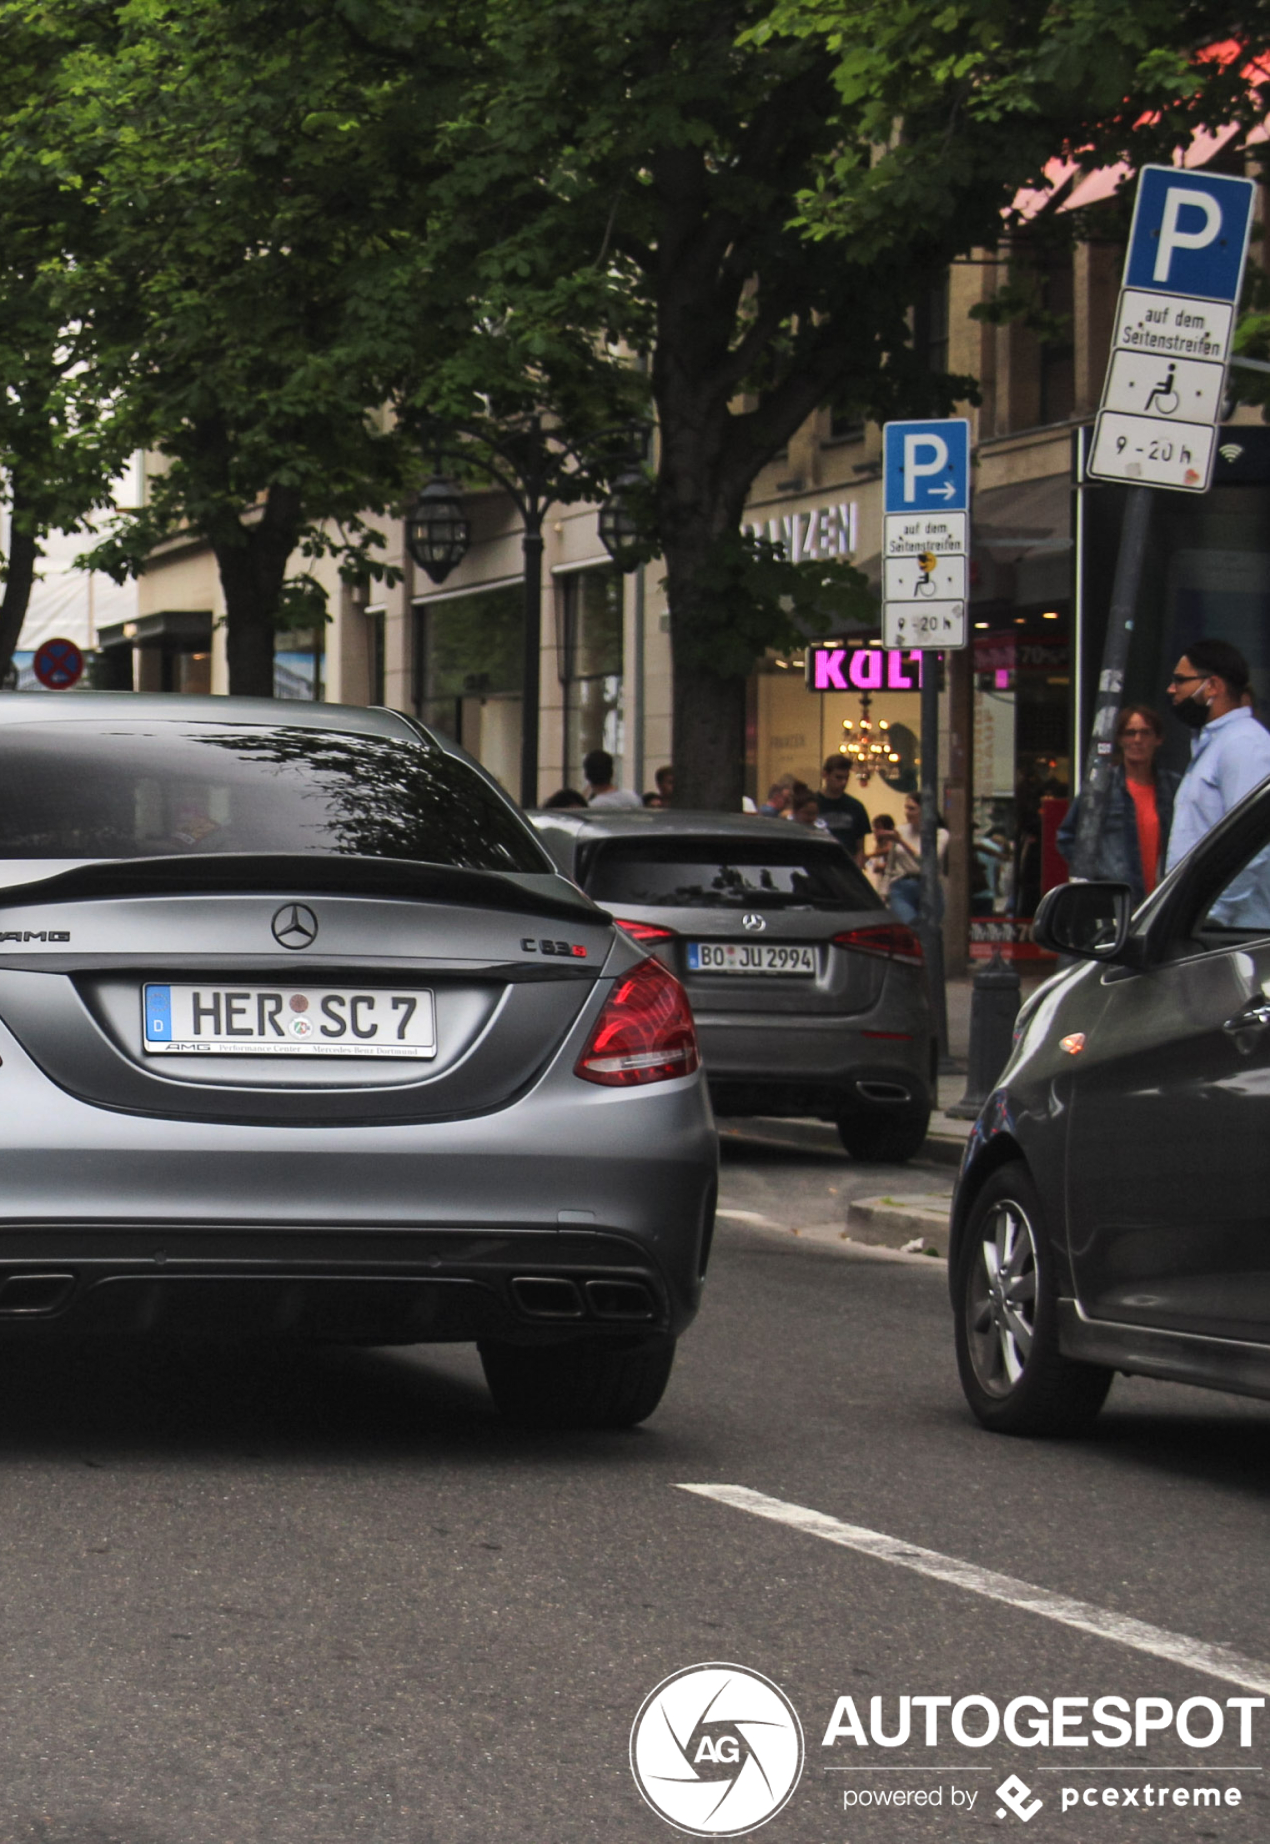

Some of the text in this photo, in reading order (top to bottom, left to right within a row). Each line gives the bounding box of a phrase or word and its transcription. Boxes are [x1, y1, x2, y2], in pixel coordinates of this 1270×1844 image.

[1153, 187, 1223, 283] P
[1145, 307, 1205, 329] auf dem
[1122, 326, 1220, 356] Seitenstreifen
[1116, 436, 1127, 455] 9
[1179, 444, 1192, 464] h
[903, 433, 949, 503] P
[903, 522, 948, 535] auf dem
[890, 537, 961, 553] Seitenstreifen
[921, 616, 938, 632] 20
[701, 946, 812, 968] BO JU 2994
[153, 1020, 164, 1032] D
[192, 992, 417, 1039] HER SC 7
[219, 1044, 270, 1053] Performance
[273, 1045, 301, 1054] Center
[313, 1046, 374, 1055] Mercedes-Benz
[377, 1047, 418, 1056] Dortmund
